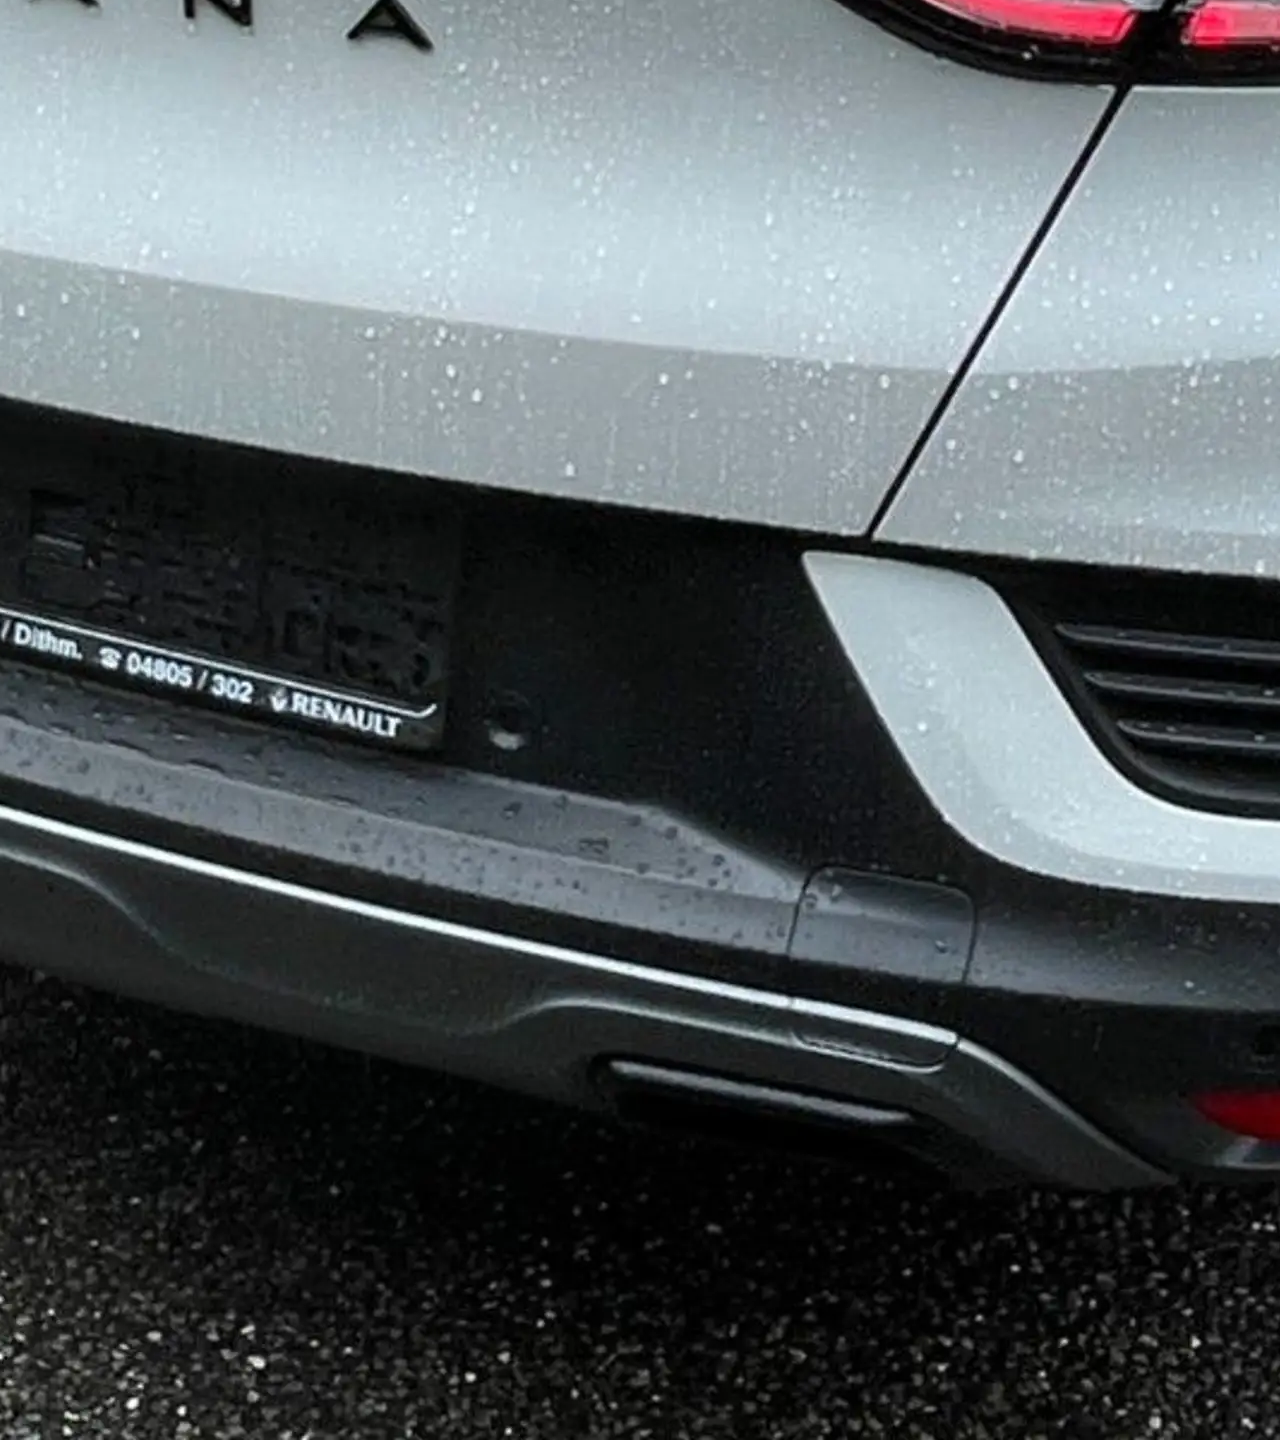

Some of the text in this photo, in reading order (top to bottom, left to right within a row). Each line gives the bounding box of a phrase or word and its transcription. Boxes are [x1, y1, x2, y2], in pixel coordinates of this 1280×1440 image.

[126, 651, 193, 689] 04805
[210, 672, 255, 705] 302
[292, 691, 403, 738] RENAULT
